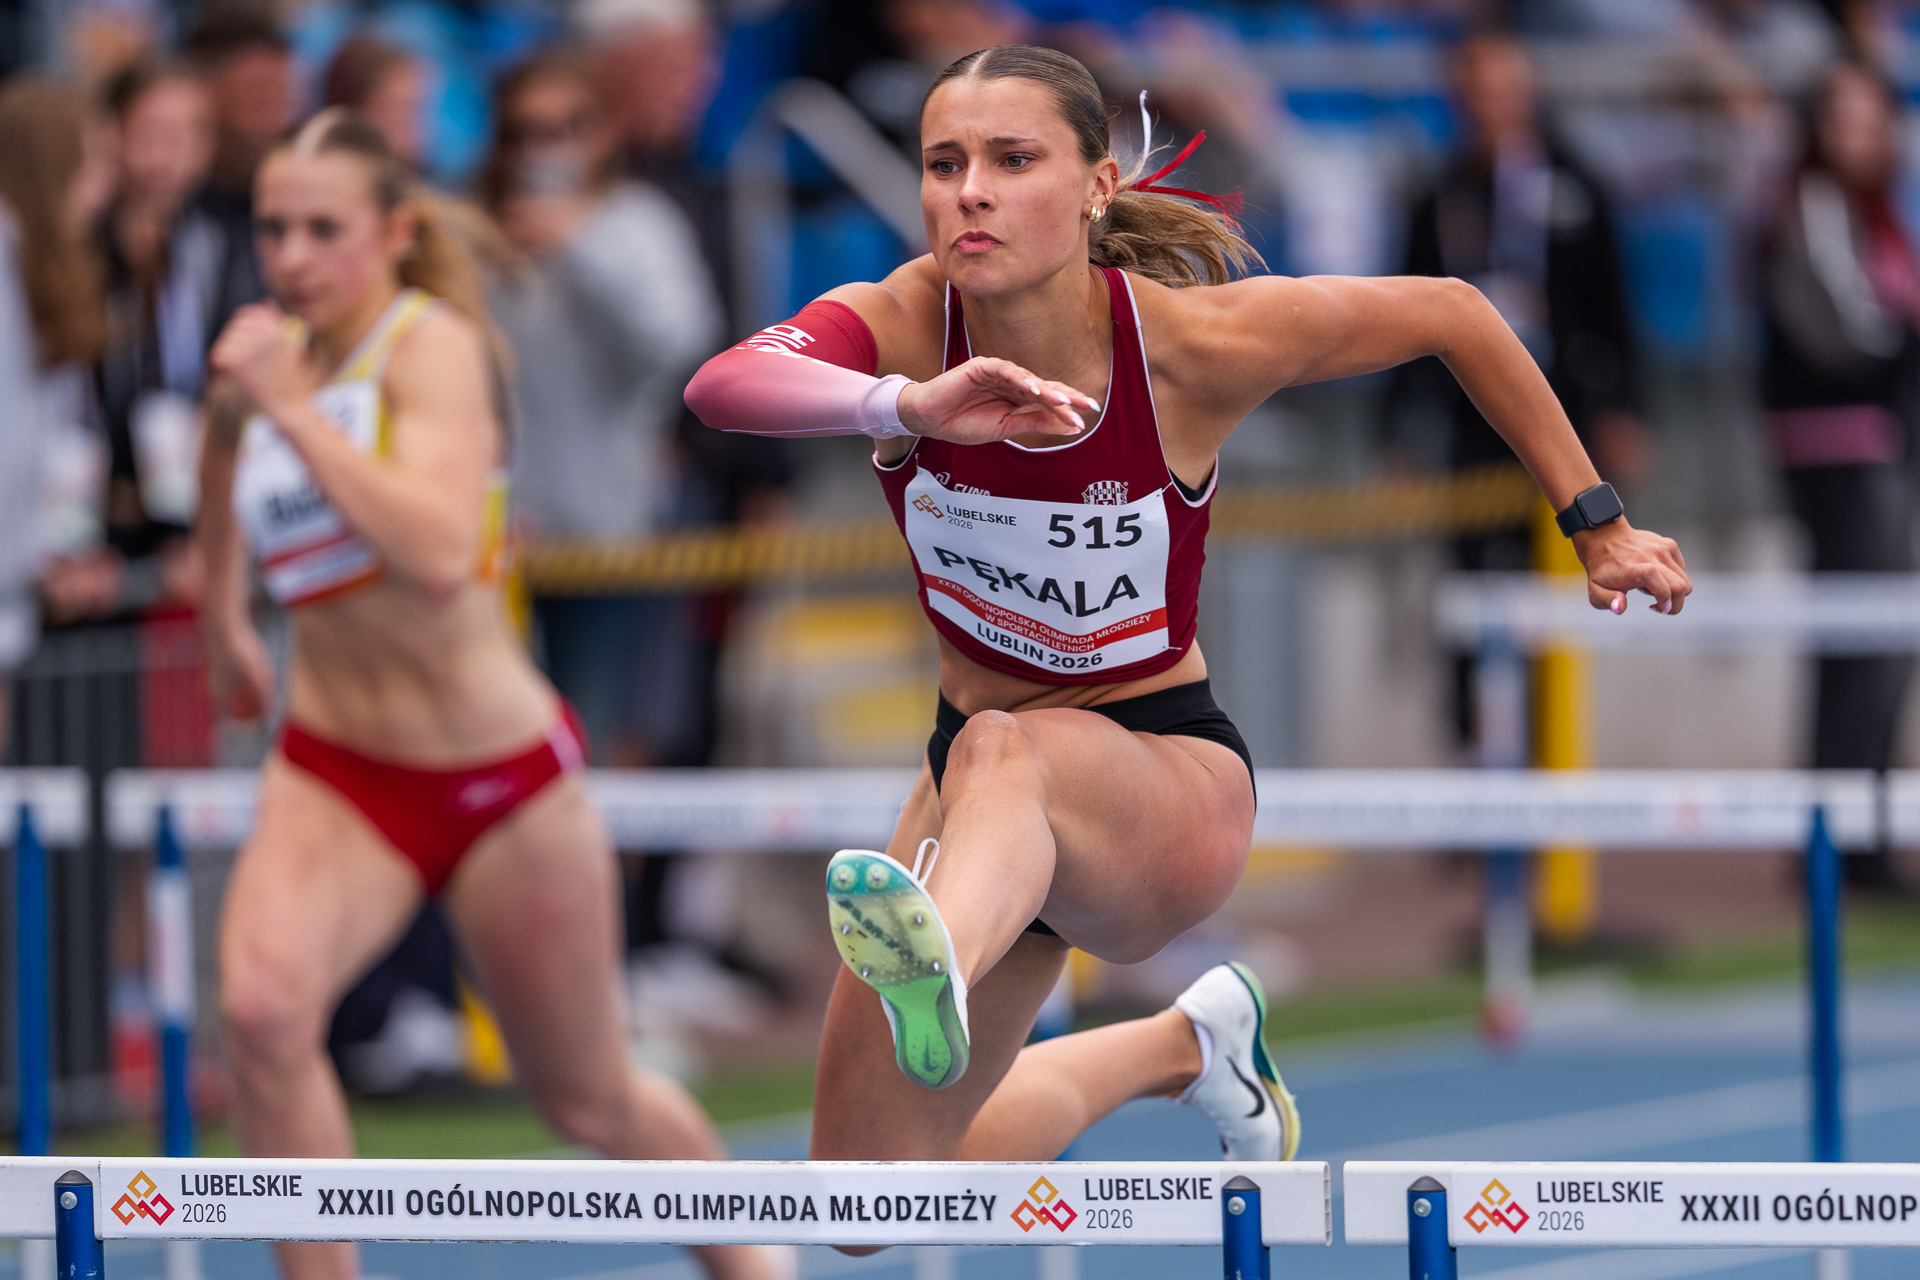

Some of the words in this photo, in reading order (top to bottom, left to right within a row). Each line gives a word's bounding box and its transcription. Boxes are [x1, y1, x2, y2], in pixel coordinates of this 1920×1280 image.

[946, 504, 1017, 526] LUBELSKIE
[947, 515, 973, 530] 2026
[1048, 513, 1142, 549] 515
[932, 546, 1140, 618] PĘKALA
[937, 578, 962, 593] XXXII
[963, 590, 1037, 630] OGÓLNOPOLSKA
[1039, 625, 1094, 644] OLIMPIADA
[1096, 613, 1151, 640] MŁODZIEŻY
[985, 612, 995, 623] W
[997, 619, 1050, 645] SPORTACH
[1051, 639, 1095, 652] LETNICH
[977, 622, 1044, 661] LUBLIN
[1048, 653, 1103, 669] 2026
[181, 1174, 302, 1197] LUBELSKIE
[1084, 1177, 1213, 1201] LUBELSKIE
[1537, 1181, 1664, 1203] LUBELSKIE
[182, 1203, 226, 1223] 2026
[318, 1188, 394, 1216] XXXII
[406, 1184, 642, 1219] OGÓLNOPOLSKA
[653, 1193, 819, 1222] OLIMPIADA
[830, 1188, 997, 1222] MŁODZIEŻY
[1681, 1195, 1760, 1222] XXXII
[1773, 1188, 1918, 1222] OGÓLNOP
[1086, 1208, 1133, 1229] 2026
[1538, 1211, 1584, 1231] 2026
